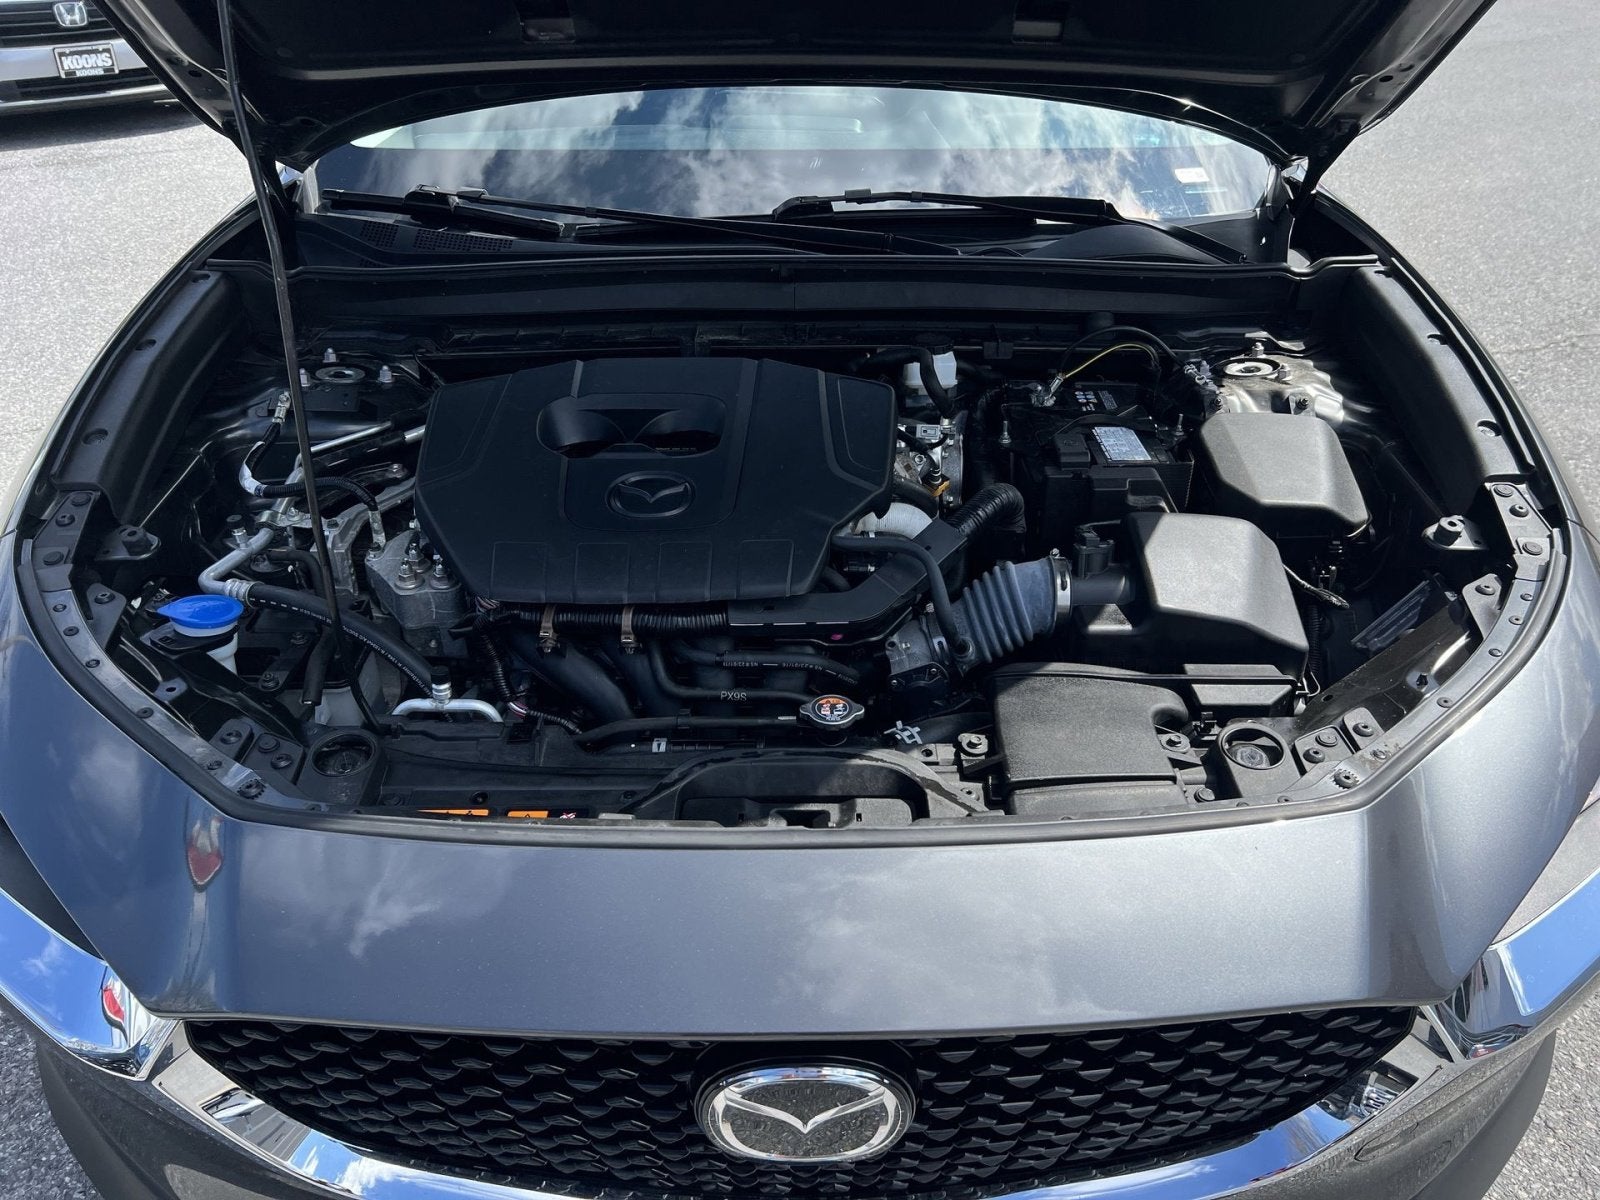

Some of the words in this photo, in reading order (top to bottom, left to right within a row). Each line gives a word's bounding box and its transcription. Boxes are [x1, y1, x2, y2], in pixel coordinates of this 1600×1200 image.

[61, 53, 113, 70] KOONS
[76, 68, 104, 76] KOONS
[720, 690, 747, 701] PX9S
